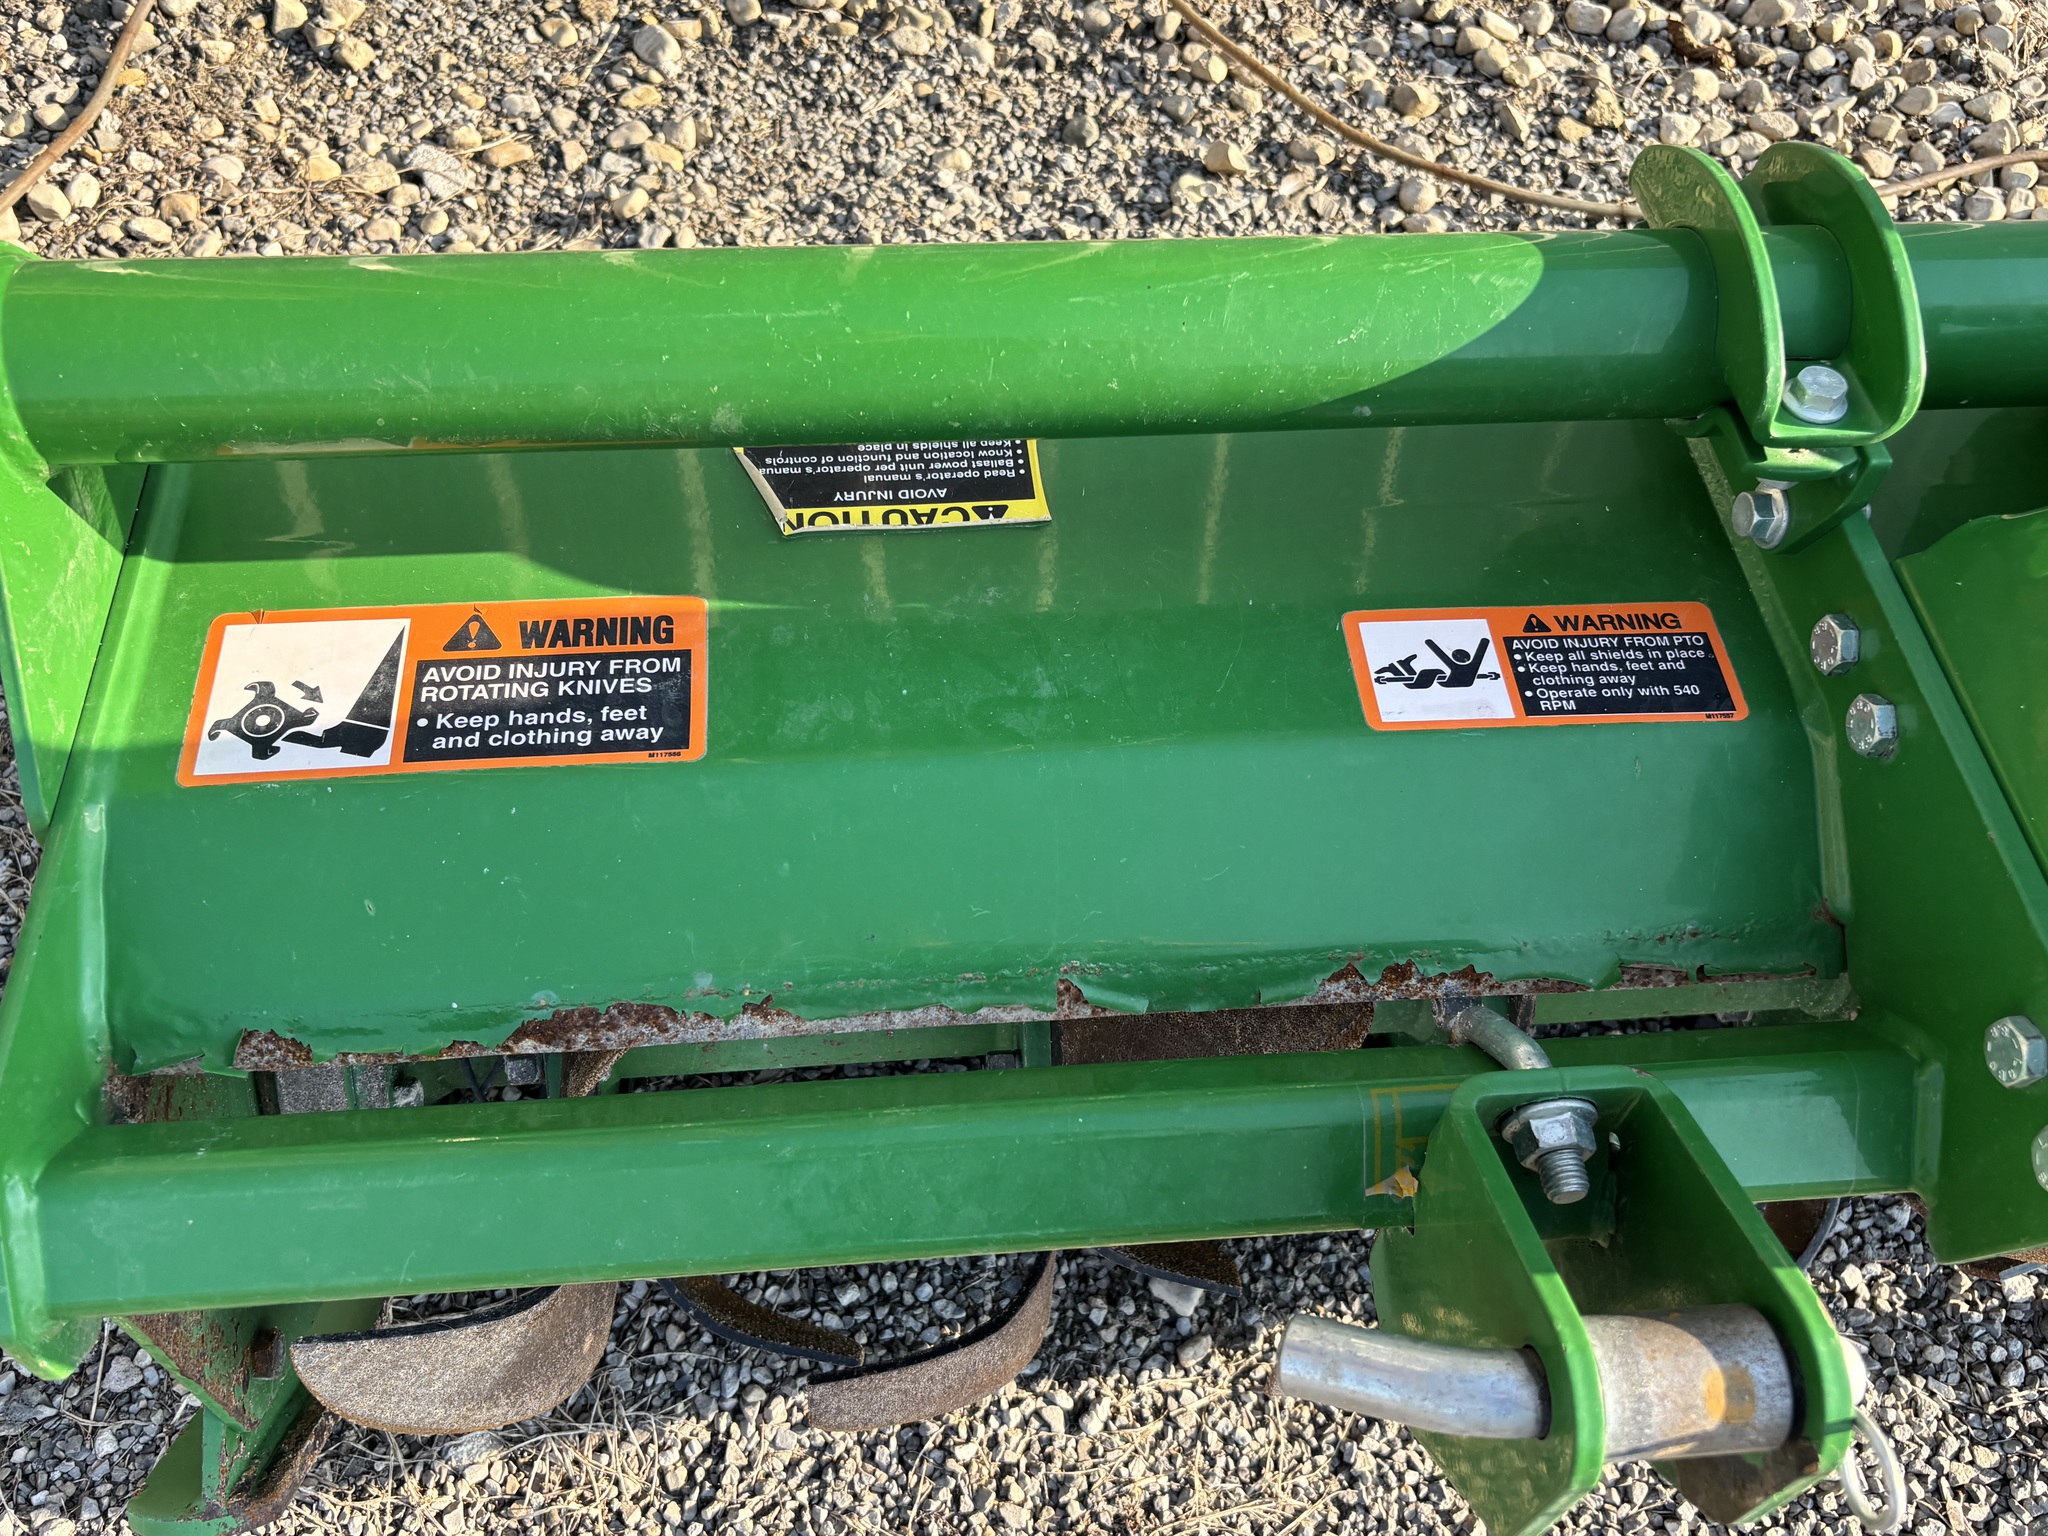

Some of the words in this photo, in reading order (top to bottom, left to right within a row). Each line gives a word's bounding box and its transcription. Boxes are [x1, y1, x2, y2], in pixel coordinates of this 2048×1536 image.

[858, 444, 892, 452] place
[896, 443, 908, 451] in
[912, 441, 958, 450] shields
[838, 454, 891, 463] function
[896, 453, 920, 462] and
[924, 451, 974, 460] location
[978, 449, 1013, 458] Know
[765, 456, 818, 466] controls
[821, 456, 834, 464] of
[929, 460, 968, 469] power
[972, 459, 1014, 468] Ballast
[806, 463, 870, 475] operator's
[875, 462, 896, 472] per
[900, 462, 925, 472] unit
[864, 473, 911, 483] manual
[916, 469, 980, 481] operator's
[984, 469, 1016, 478] Read
[834, 490, 892, 501] INJURY
[898, 488, 947, 499] AVOID
[1552, 612, 1682, 632] WARNING
[519, 615, 674, 649] WARNING
[1512, 638, 1558, 650] AVOID
[1563, 637, 1618, 648] INJURY
[1624, 636, 1670, 646] FROM
[1673, 635, 1704, 646] PTO
[1524, 652, 1564, 663] Keep
[1568, 650, 1586, 661] all
[1590, 648, 1644, 660] shields
[1648, 648, 1662, 658] in
[1665, 648, 1705, 660] place
[422, 664, 501, 683] AVOID
[509, 660, 602, 678] INJURY
[609, 657, 681, 674] FROM
[1528, 663, 1568, 675] Keep
[1572, 662, 1622, 673] hands,
[1626, 660, 1654, 671] feet
[1656, 660, 1686, 670] and
[1532, 674, 1595, 686] clothing
[1598, 674, 1636, 685] away
[420, 682, 549, 702] ROTATING
[558, 678, 652, 696] KNIVES
[1536, 688, 1597, 700] Operate
[1602, 686, 1634, 698] only
[1637, 686, 1670, 696] with
[1673, 685, 1700, 696] 540
[1540, 700, 1576, 711] RPM
[436, 713, 500, 730] Keep
[508, 708, 593, 726] hands,
[600, 705, 647, 722] feet
[432, 732, 480, 750] and
[488, 728, 592, 747] clothing
[600, 726, 664, 744] away
